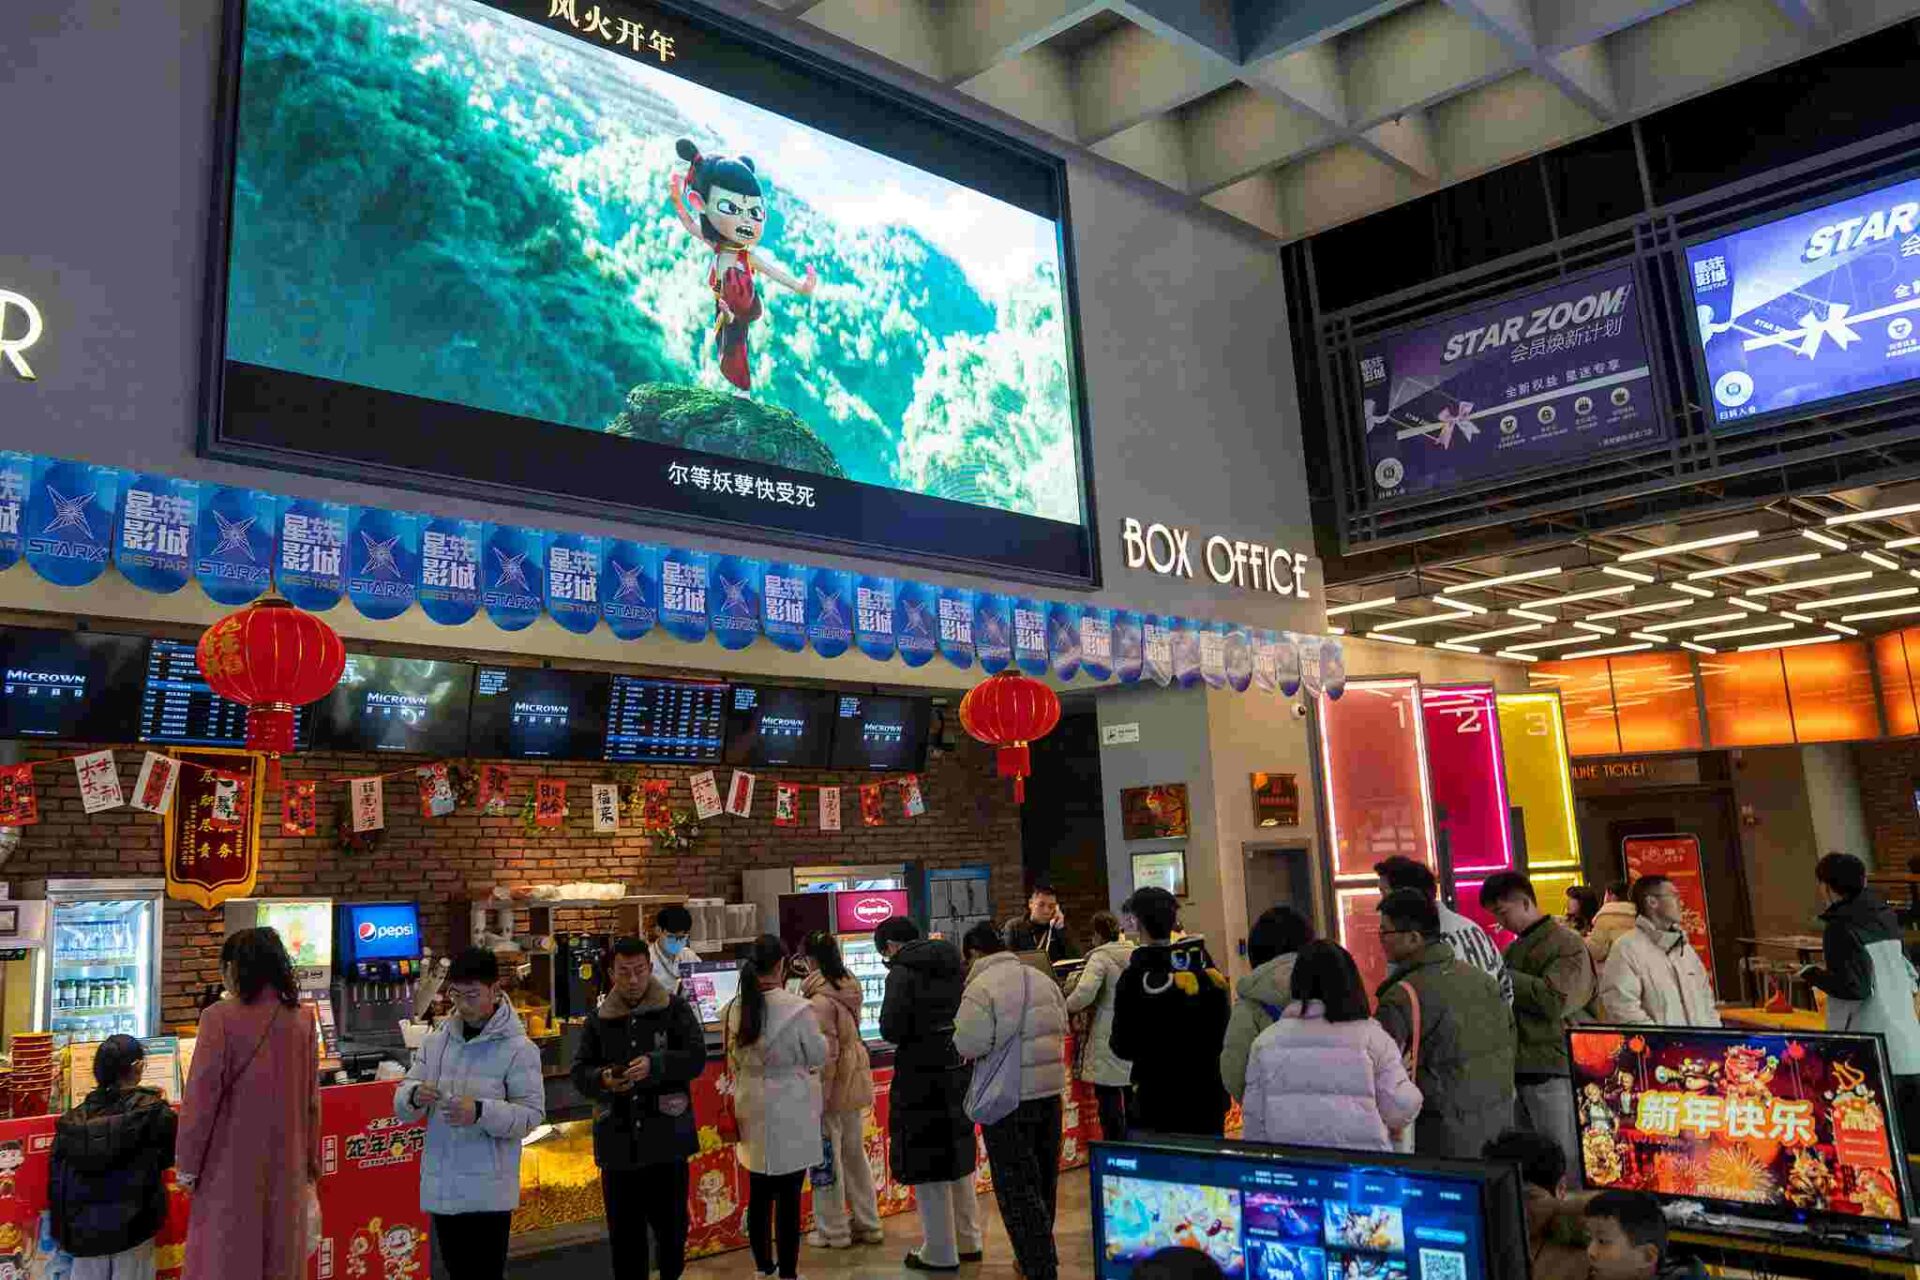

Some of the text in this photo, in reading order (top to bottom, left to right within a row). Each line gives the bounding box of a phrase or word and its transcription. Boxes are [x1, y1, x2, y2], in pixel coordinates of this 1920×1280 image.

[547, 0, 676, 61] 风火开年
[1803, 202, 1919, 260] STAR
[1444, 284, 1631, 361] STAR ZOOM
[668, 461, 816, 508] 尔等妖孽快受死
[28, 538, 108, 563] STARX
[123, 519, 190, 557] 影城
[196, 559, 269, 581] STARX
[282, 541, 341, 577] 影城
[1122, 517, 1310, 598] BOX OFFICE
[350, 578, 415, 598] STARX
[422, 557, 476, 591] 影城
[550, 571, 597, 603] 影城
[484, 591, 541, 610] STARX
[605, 601, 657, 621] STARX
[662, 584, 706, 613] 影城
[765, 597, 805, 624] 影城
[6, 668, 87, 685] MICROWN
[367, 692, 428, 706] MICROWN
[514, 702, 569, 714] MICROWN
[1391, 700, 1406, 729] 1
[1455, 706, 1482, 734] 2
[1525, 712, 1548, 736] 3
[378, 923, 414, 939] pepsi
[1640, 1091, 1814, 1143] 新年快乐
